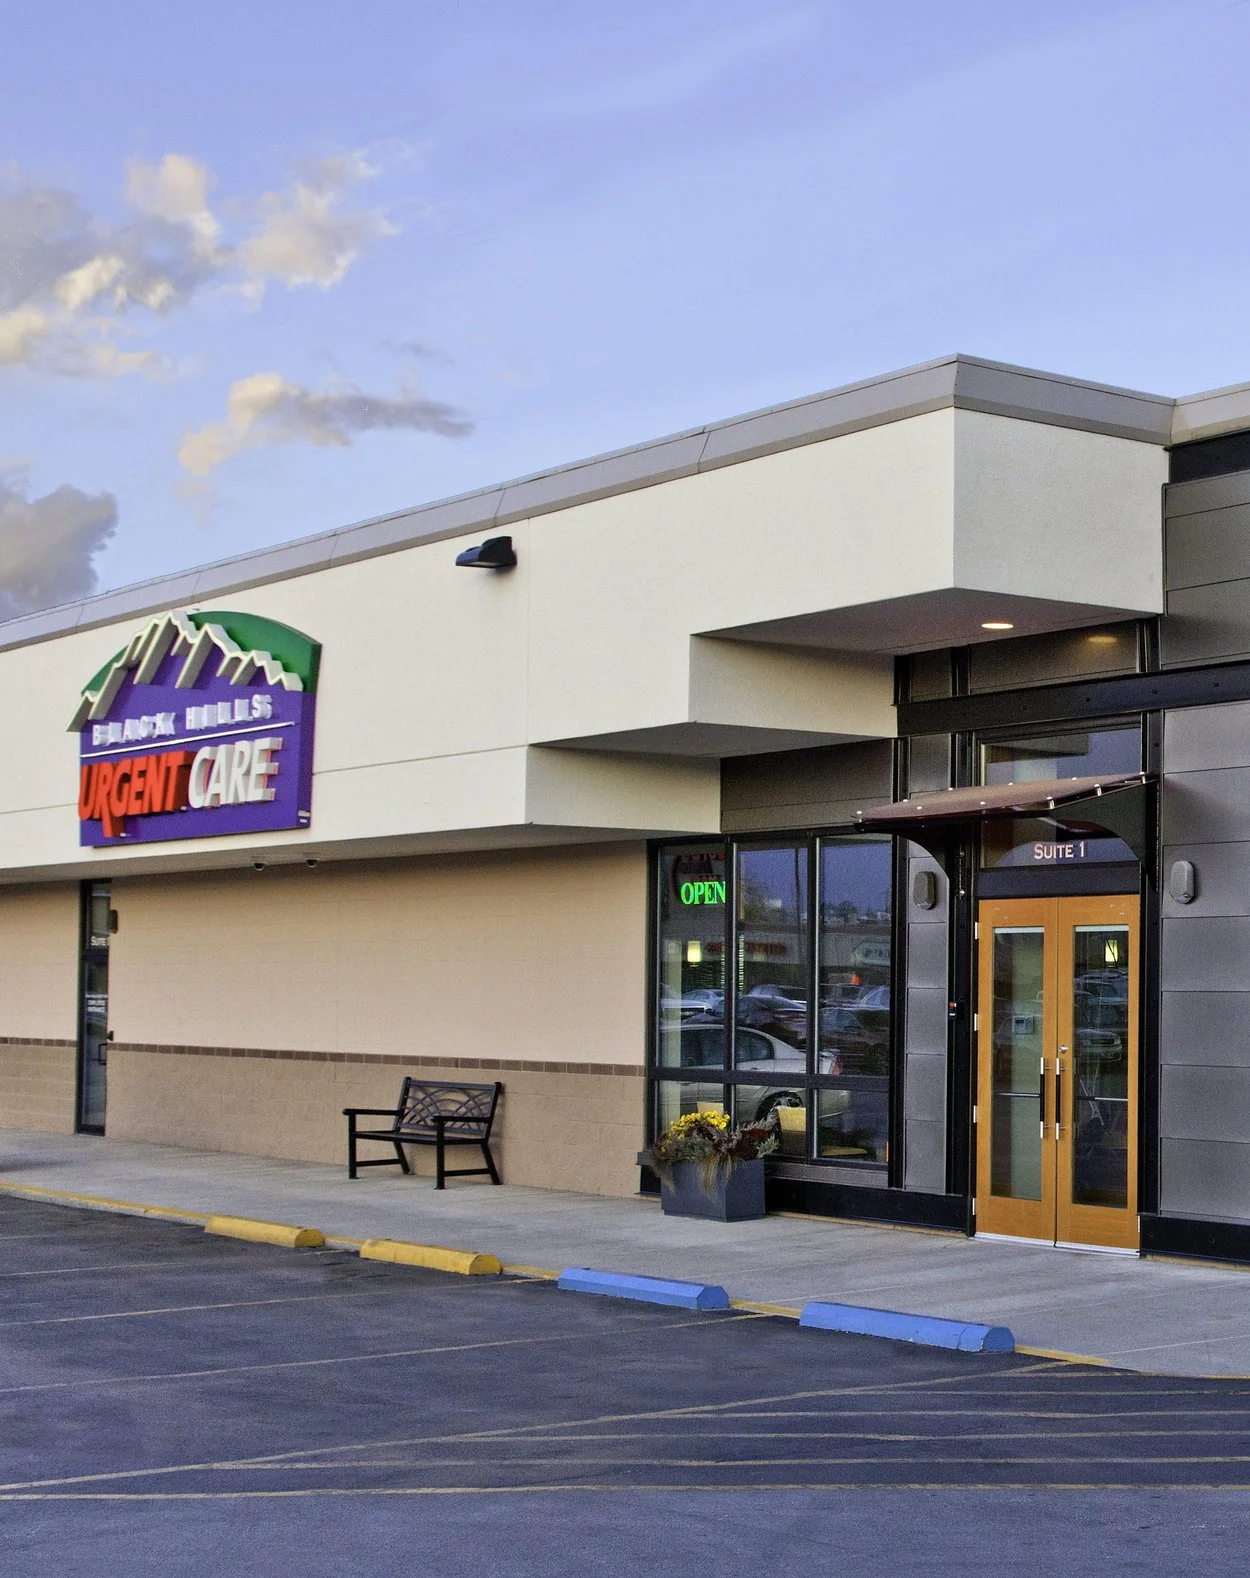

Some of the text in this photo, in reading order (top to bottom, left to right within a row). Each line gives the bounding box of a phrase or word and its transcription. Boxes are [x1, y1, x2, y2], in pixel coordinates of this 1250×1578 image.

[92, 694, 272, 746] BLACK HILLS
[78, 737, 283, 838] URGENT CARE
[1033, 840, 1085, 860] SUITE 1
[680, 881, 727, 905] OPEN
